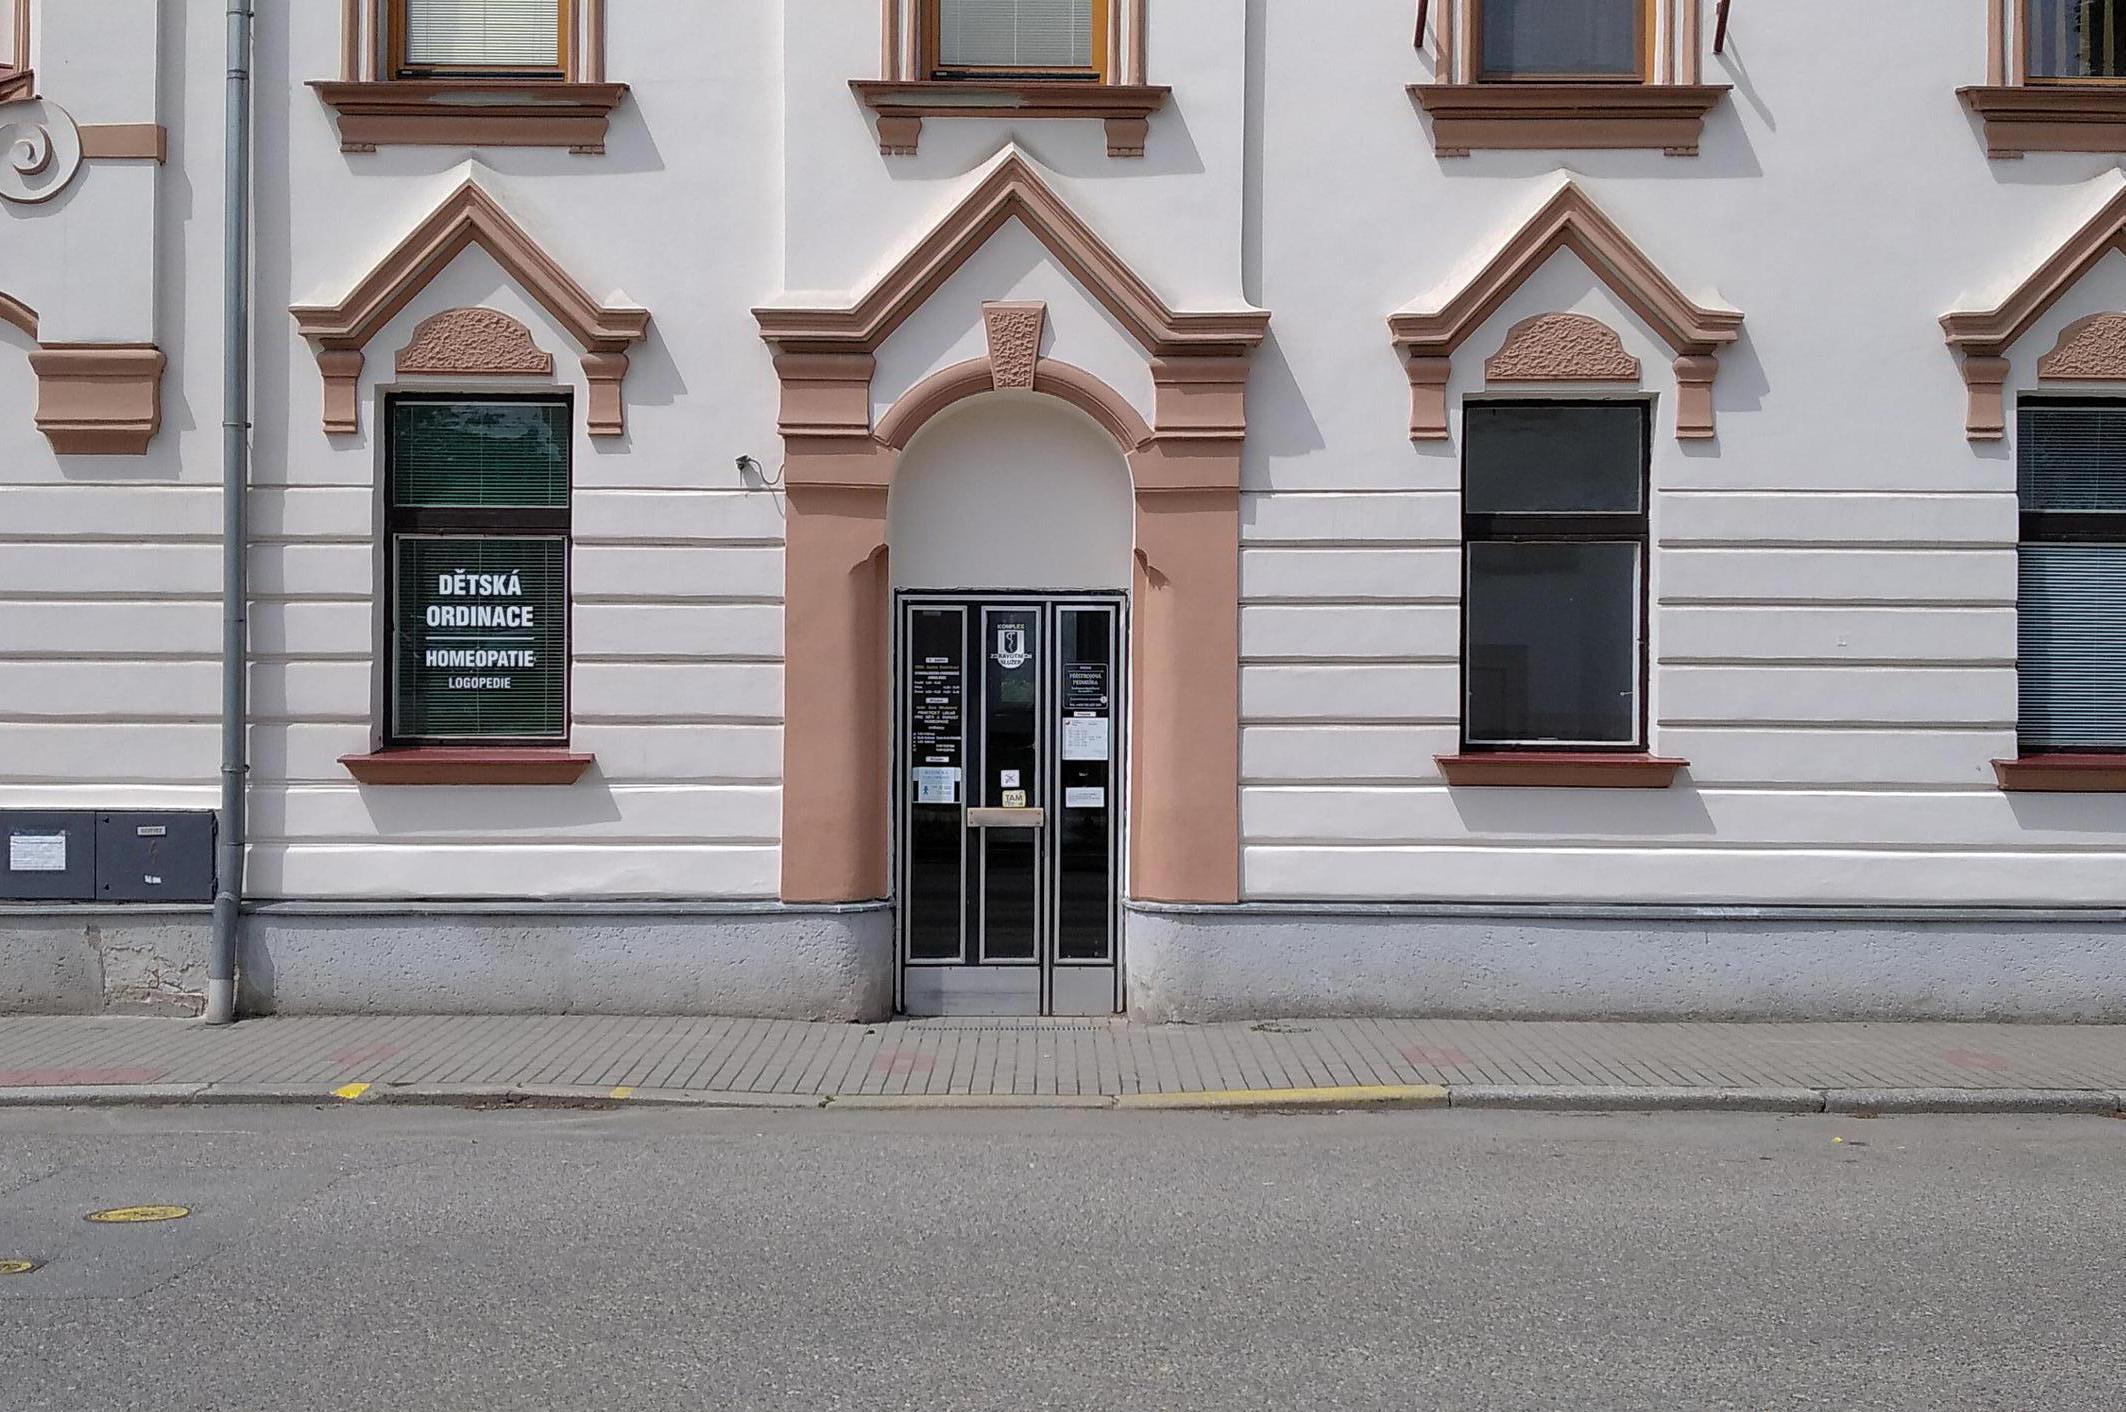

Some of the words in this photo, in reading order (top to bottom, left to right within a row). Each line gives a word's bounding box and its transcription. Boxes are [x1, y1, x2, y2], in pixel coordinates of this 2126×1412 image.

[438, 568, 522, 596] DĚTSKÁ
[426, 605, 534, 628] ORDINACE
[425, 650, 534, 667] HOMEOPATIE
[448, 677, 511, 689] LOGOPEDIE
[1005, 794, 1023, 802] TAM
